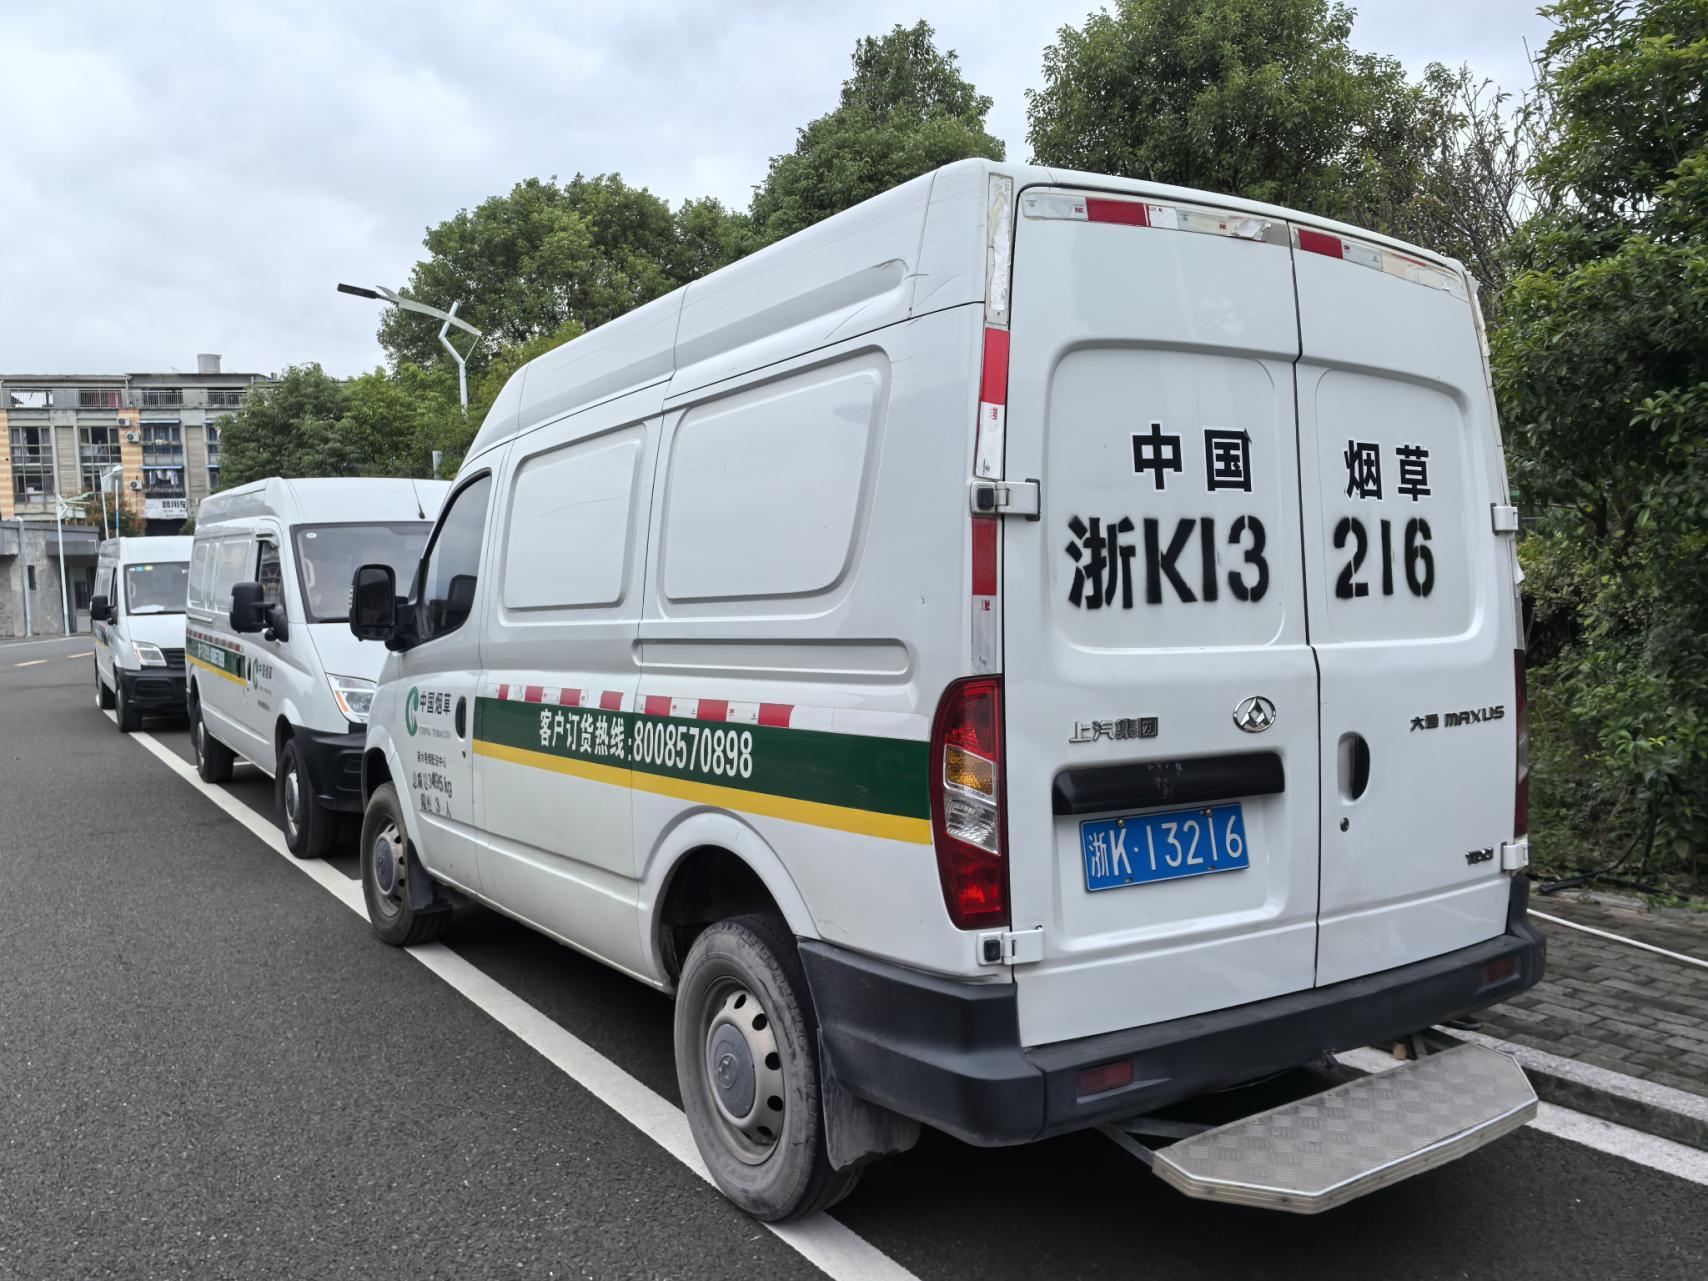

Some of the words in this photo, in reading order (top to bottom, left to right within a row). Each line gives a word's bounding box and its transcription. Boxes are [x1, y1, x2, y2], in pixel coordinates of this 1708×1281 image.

[1132, 423, 1252, 492] 中国
[1345, 440, 1431, 501] 烟草
[1065, 514, 1269, 609] 浙K13
[1333, 517, 1435, 599] 216
[420, 690, 451, 716] 中国烟草
[1444, 705, 1505, 728] MAXUS
[1068, 717, 1159, 743] 上汽集团
[1088, 815, 1243, 878] 浙K·13216
